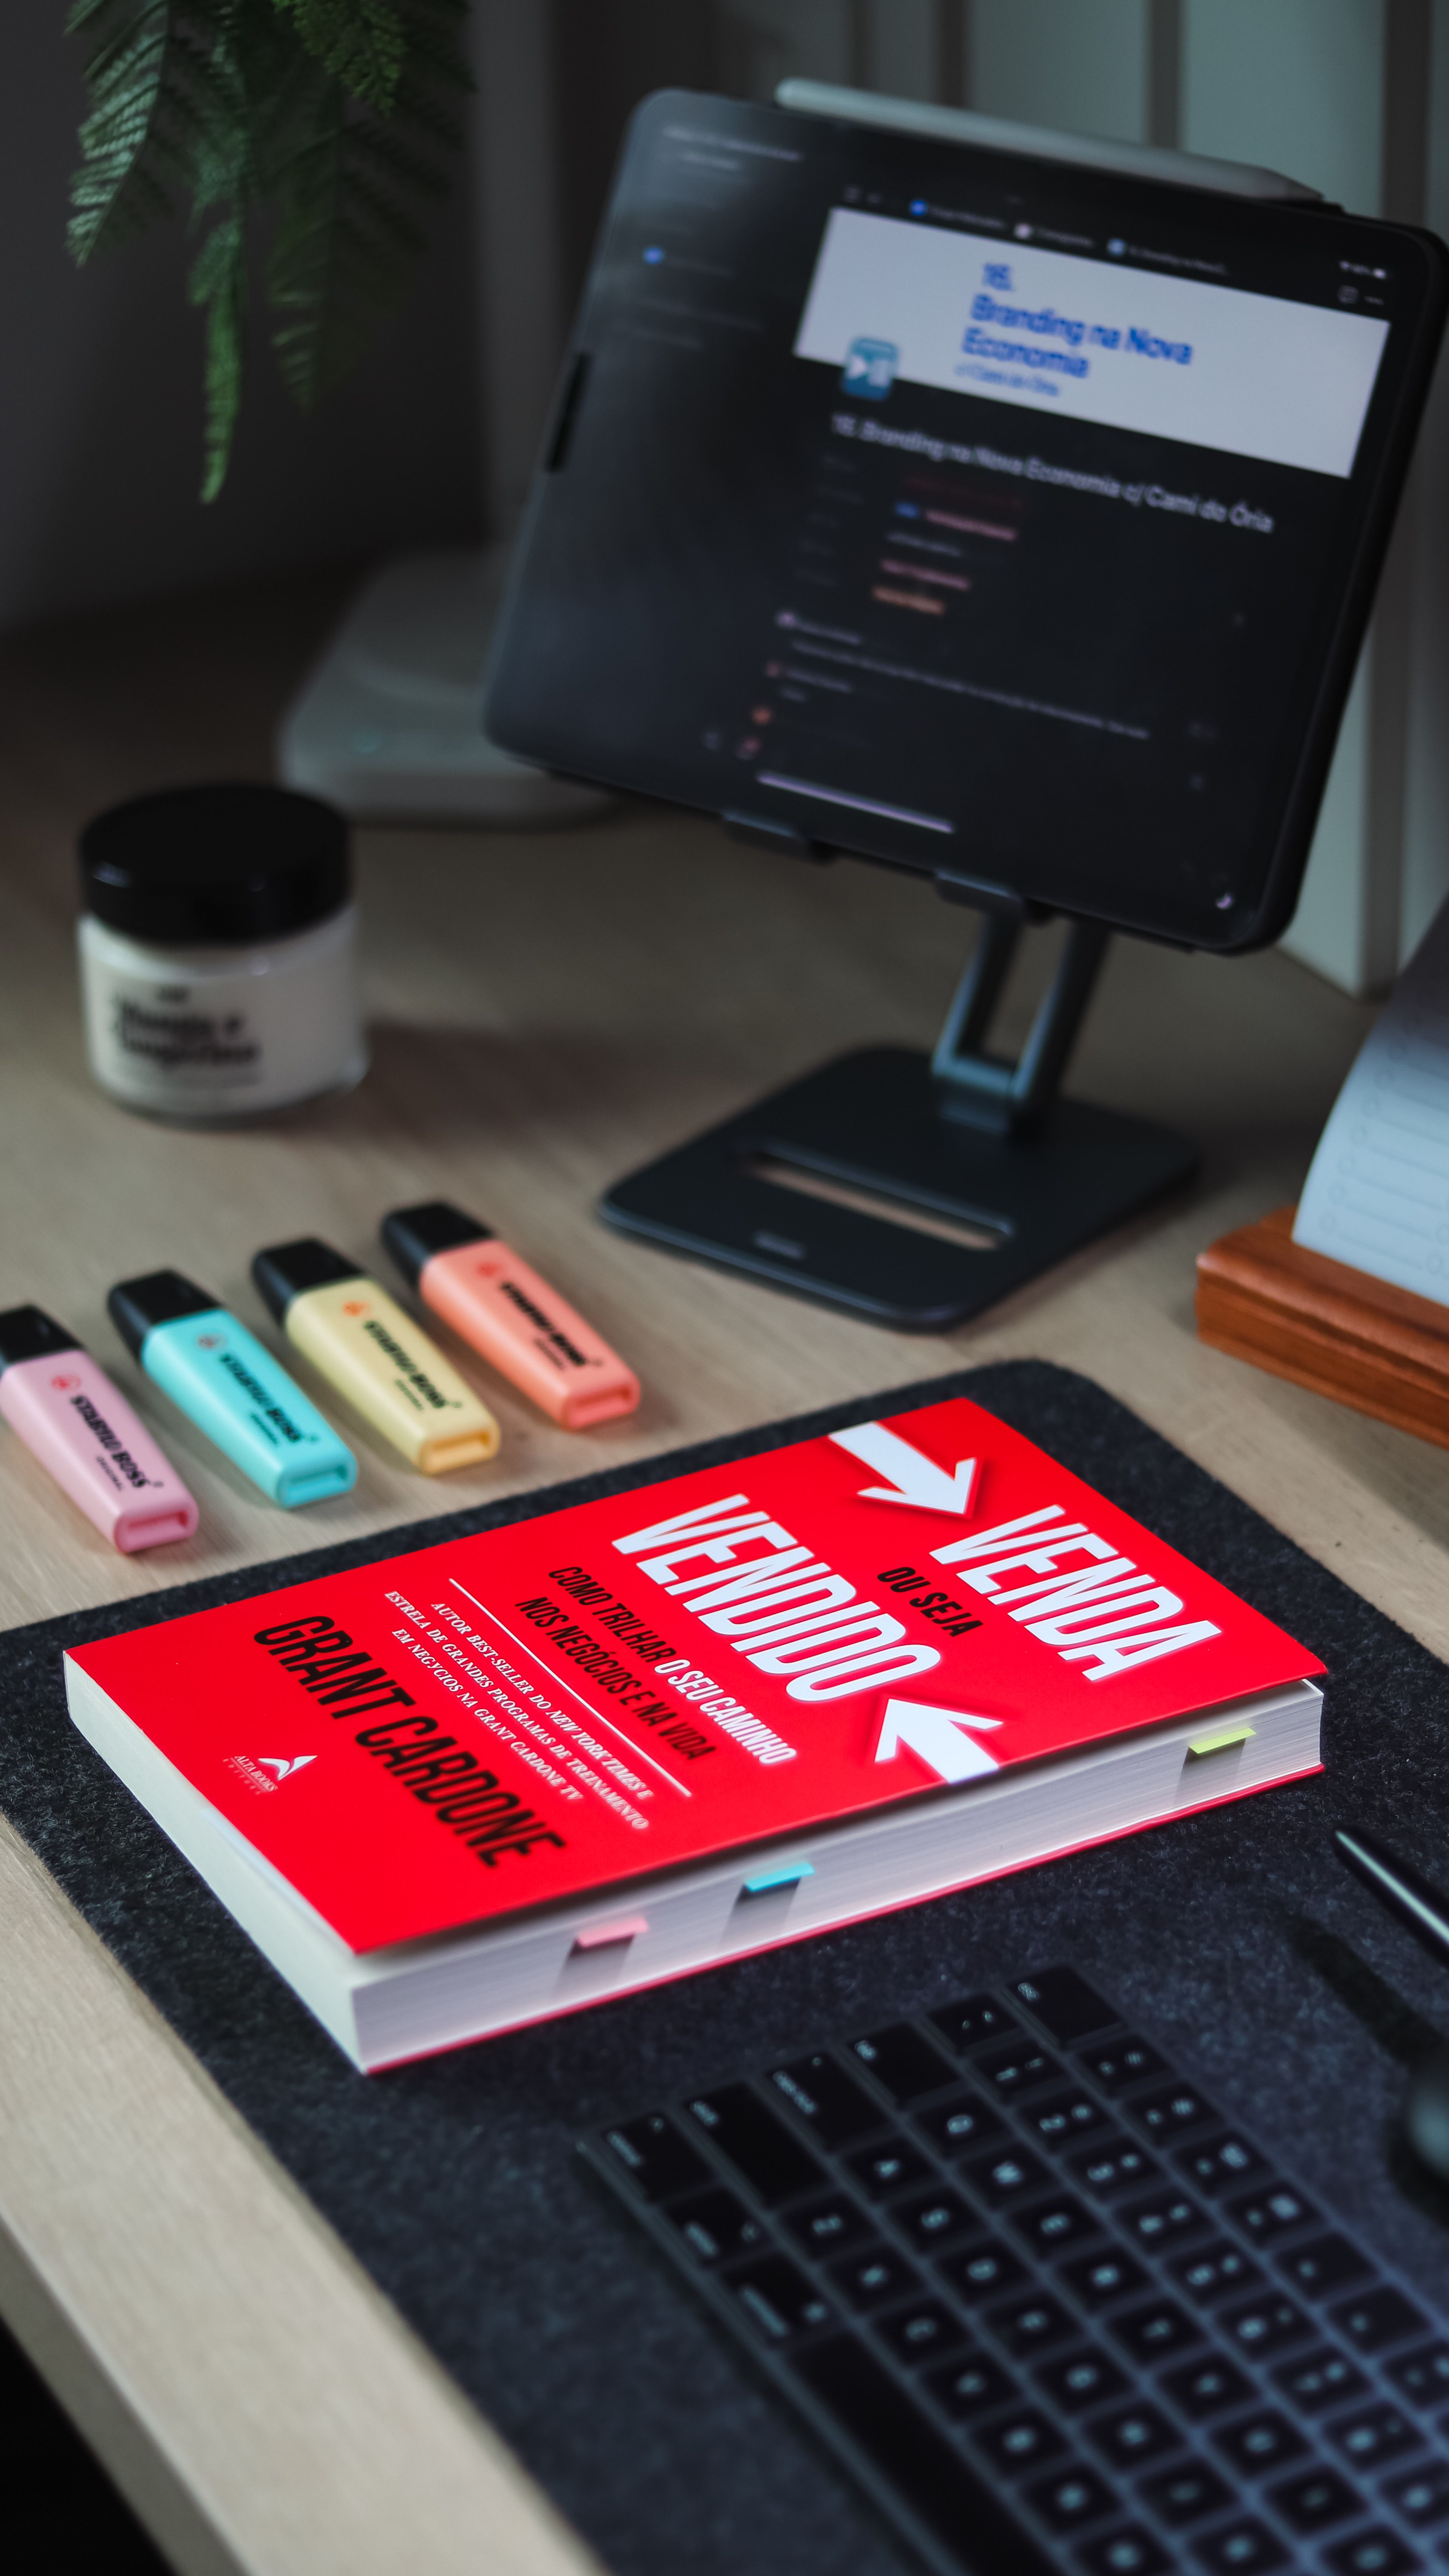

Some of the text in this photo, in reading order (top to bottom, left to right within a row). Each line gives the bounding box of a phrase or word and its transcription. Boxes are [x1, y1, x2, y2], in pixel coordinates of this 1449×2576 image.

[962, 326, 1089, 379] Economia
[971, 293, 1193, 366] Branding na Nova
[861, 420, 945, 462] Branding
[975, 446, 1024, 476] Nova
[1025, 456, 1120, 499] Economia
[70, 1394, 149, 1489] STABILO BOSS
[548, 1567, 797, 1764] COMO TRILHAR O SEU CAMINHO
[612, 1493, 941, 1702] VENDIDO
[877, 1566, 984, 1637] OU SEJA
[929, 1504, 1222, 1681] VENDA
[254, 1616, 567, 1868] GRANT CARDONE
[384, 1591, 649, 1829] ESTRELA DE GRANDES PROGRAMAS DE TREINAMENTO
[392, 1628, 415, 1644] EM
[456, 1692, 479, 1708] NA
[474, 1708, 517, 1740] GRANT
[510, 1741, 567, 1787] CARDONE
[560, 1785, 584, 1800] TV
[431, 1603, 654, 1800] AUTOR BEST-SELLER DO NEW YORK TIMES E
[514, 1597, 717, 1760] NOS NEGÓCIOS E NA VIDA
[234, 1755, 278, 1792] ALTA BOOKS
